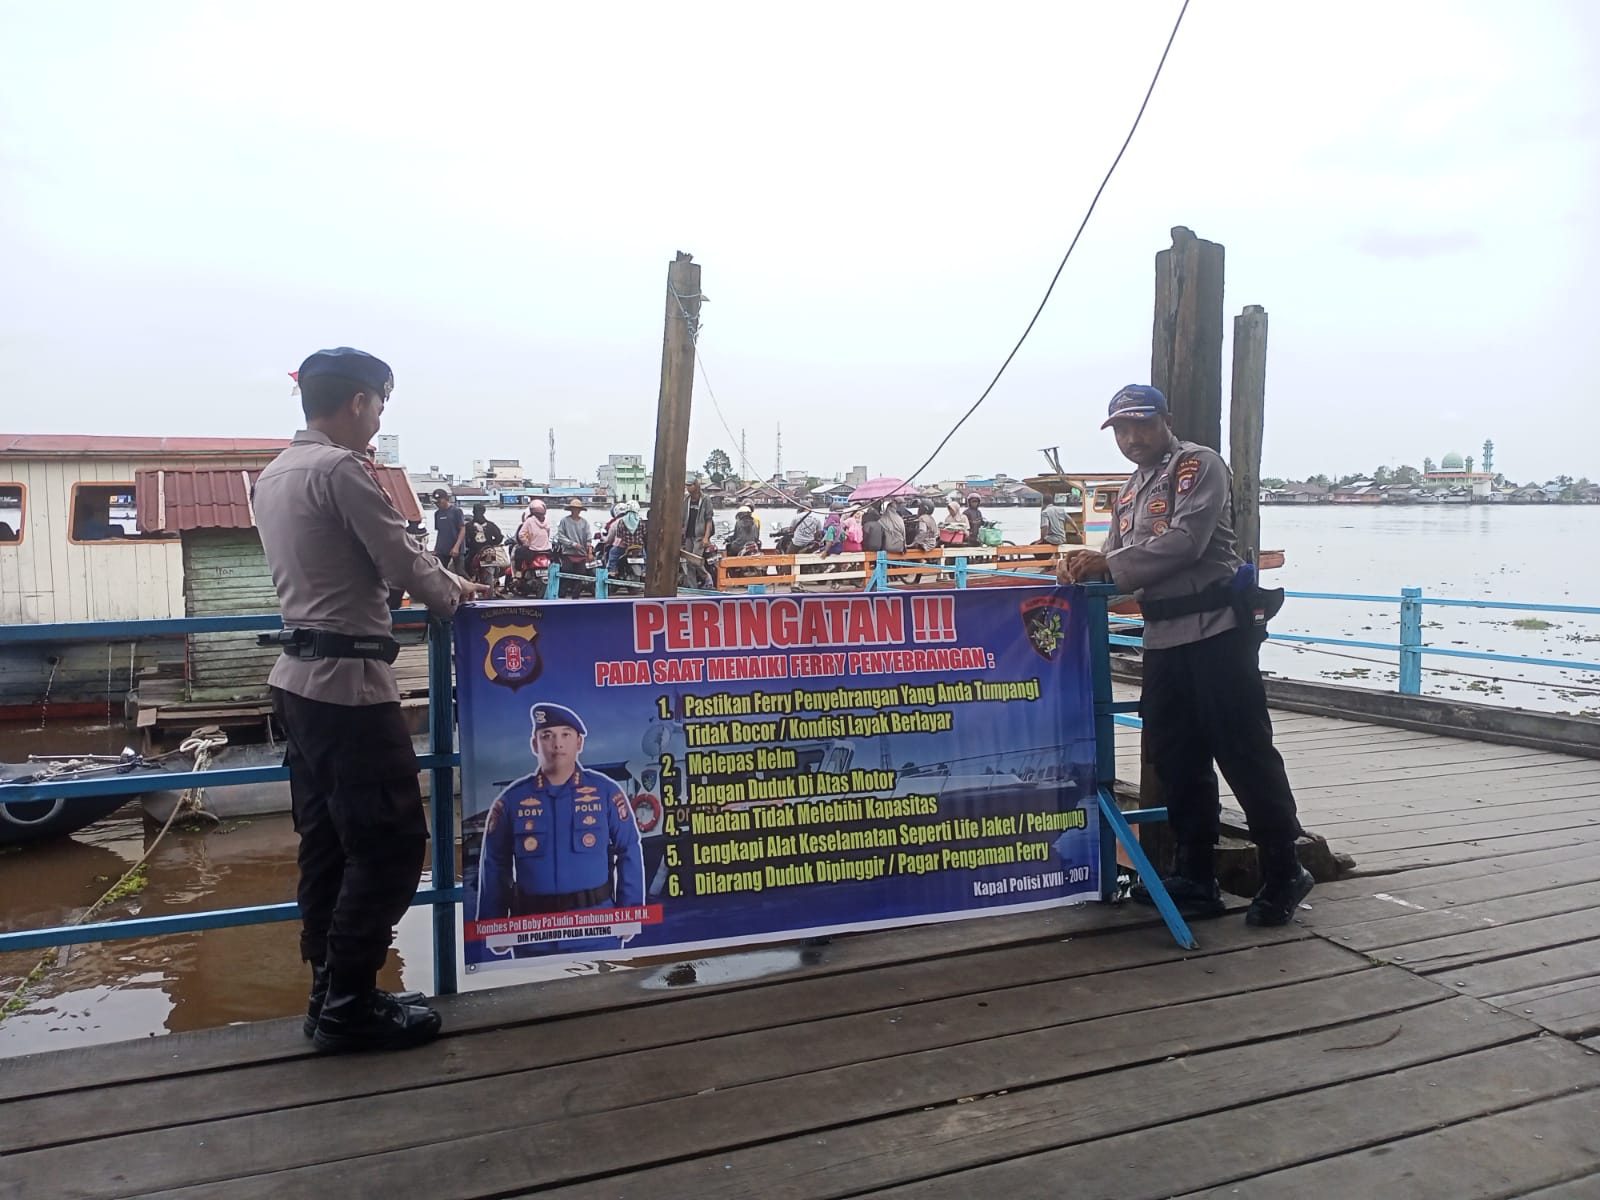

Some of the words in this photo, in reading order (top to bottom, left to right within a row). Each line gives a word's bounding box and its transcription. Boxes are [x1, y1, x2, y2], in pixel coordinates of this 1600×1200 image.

[633, 596, 905, 653] PERINGATAN
[911, 595, 957, 643] !!!
[595, 661, 651, 687] PADA
[653, 658, 705, 684] SAAT
[707, 655, 787, 682] MENAIKI
[790, 652, 846, 678] FERRY
[849, 647, 985, 675] PENYEBRANGAN
[658, 698, 672, 720] 1.
[685, 693, 751, 717] Pastikan
[754, 690, 791, 713] Ferry
[796, 686, 898, 712] Penyebrangan
[901, 684, 935, 706] Yang
[938, 682, 972, 703] Anda
[974, 679, 1039, 701] Tumpangi
[686, 724, 728, 747] Tidak
[732, 721, 776, 744] Bocor
[780, 719, 788, 740] /
[790, 717, 846, 739] Kondisi
[848, 714, 889, 736] Layak
[892, 711, 951, 733] Berlayar
[661, 754, 676, 777] 2.
[688, 752, 754, 775] Melepas
[756, 748, 796, 771] Helm
[664, 785, 678, 807] 3.
[690, 783, 744, 806] Jangan
[748, 776, 796, 800] Duduk
[798, 774, 813, 795] Di
[817, 772, 850, 794] Atas
[852, 769, 895, 791] Motor
[518, 808, 543, 817] BOBY
[575, 803, 602, 813] POLRI
[665, 814, 679, 836] 4.
[691, 812, 750, 834] Muatan
[753, 806, 794, 830] Tidak
[798, 801, 863, 825] Melebihi
[866, 796, 938, 818] Kapasitas
[667, 845, 681, 866] 5.
[693, 839, 763, 864] Lengkapi
[767, 836, 797, 856] Alat
[799, 828, 897, 854] Keselamatan
[900, 822, 952, 845] Seperti
[954, 819, 980, 839] Life
[981, 815, 1016, 837] Jaket
[1018, 814, 1024, 833] /
[1027, 808, 1085, 831] Pelampung
[669, 875, 683, 897] 6.
[695, 869, 763, 895] Dilarang
[766, 863, 813, 887] Duduk
[817, 856, 885, 883] Dipinggir
[887, 855, 896, 875] /
[899, 850, 940, 875] Pagar
[943, 845, 1015, 870] Pengaman
[1017, 842, 1049, 864] Ferry
[973, 880, 1008, 897] Kapal
[1010, 876, 1041, 892] Polisi
[1070, 867, 1089, 882] 2007
[477, 922, 507, 935] Kombes
[509, 919, 521, 933] Pol
[523, 918, 542, 931] Boby
[575, 912, 613, 925] Tambunan
[518, 932, 529, 944] DIR
[530, 929, 562, 941] POLAIRUD
[563, 927, 584, 938] POLDA
[584, 925, 612, 937] KALTENG
